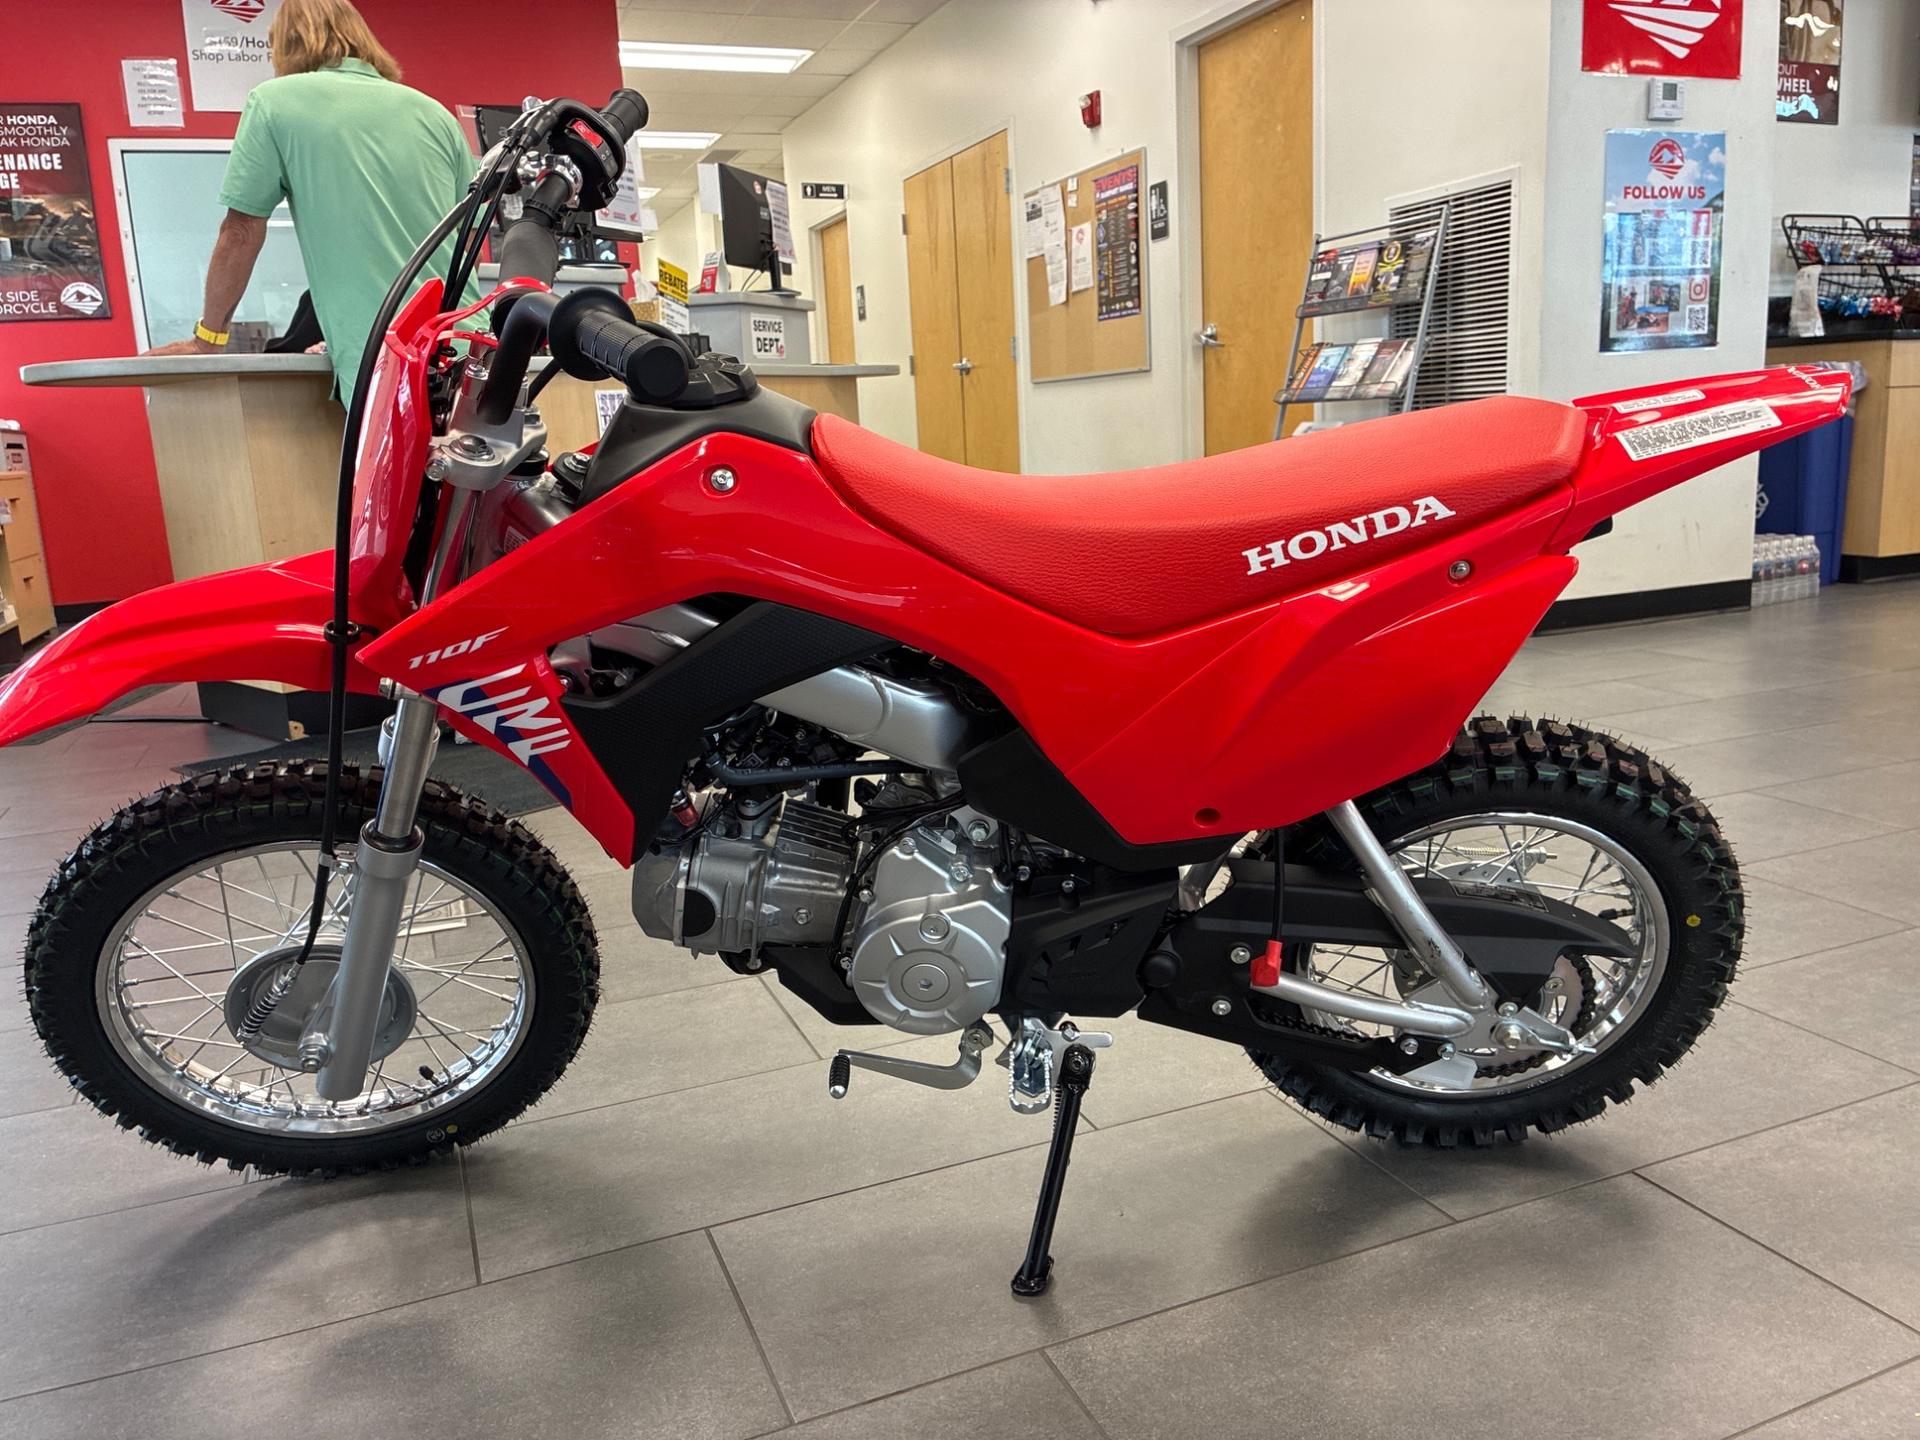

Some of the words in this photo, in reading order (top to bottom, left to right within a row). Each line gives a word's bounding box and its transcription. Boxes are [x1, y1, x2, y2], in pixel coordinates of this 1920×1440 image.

[192, 49, 224, 64] Shop
[227, 50, 263, 62] Labor
[7, 115, 57, 125] HONDA
[20, 137, 71, 147] HONDA
[1623, 186, 1684, 199] FOLLOW
[1688, 186, 1706, 199] US
[6, 290, 40, 302] SIDE
[753, 320, 782, 333] SERVICE
[1242, 495, 1456, 575] HONDA
[408, 626, 510, 670] 110F
